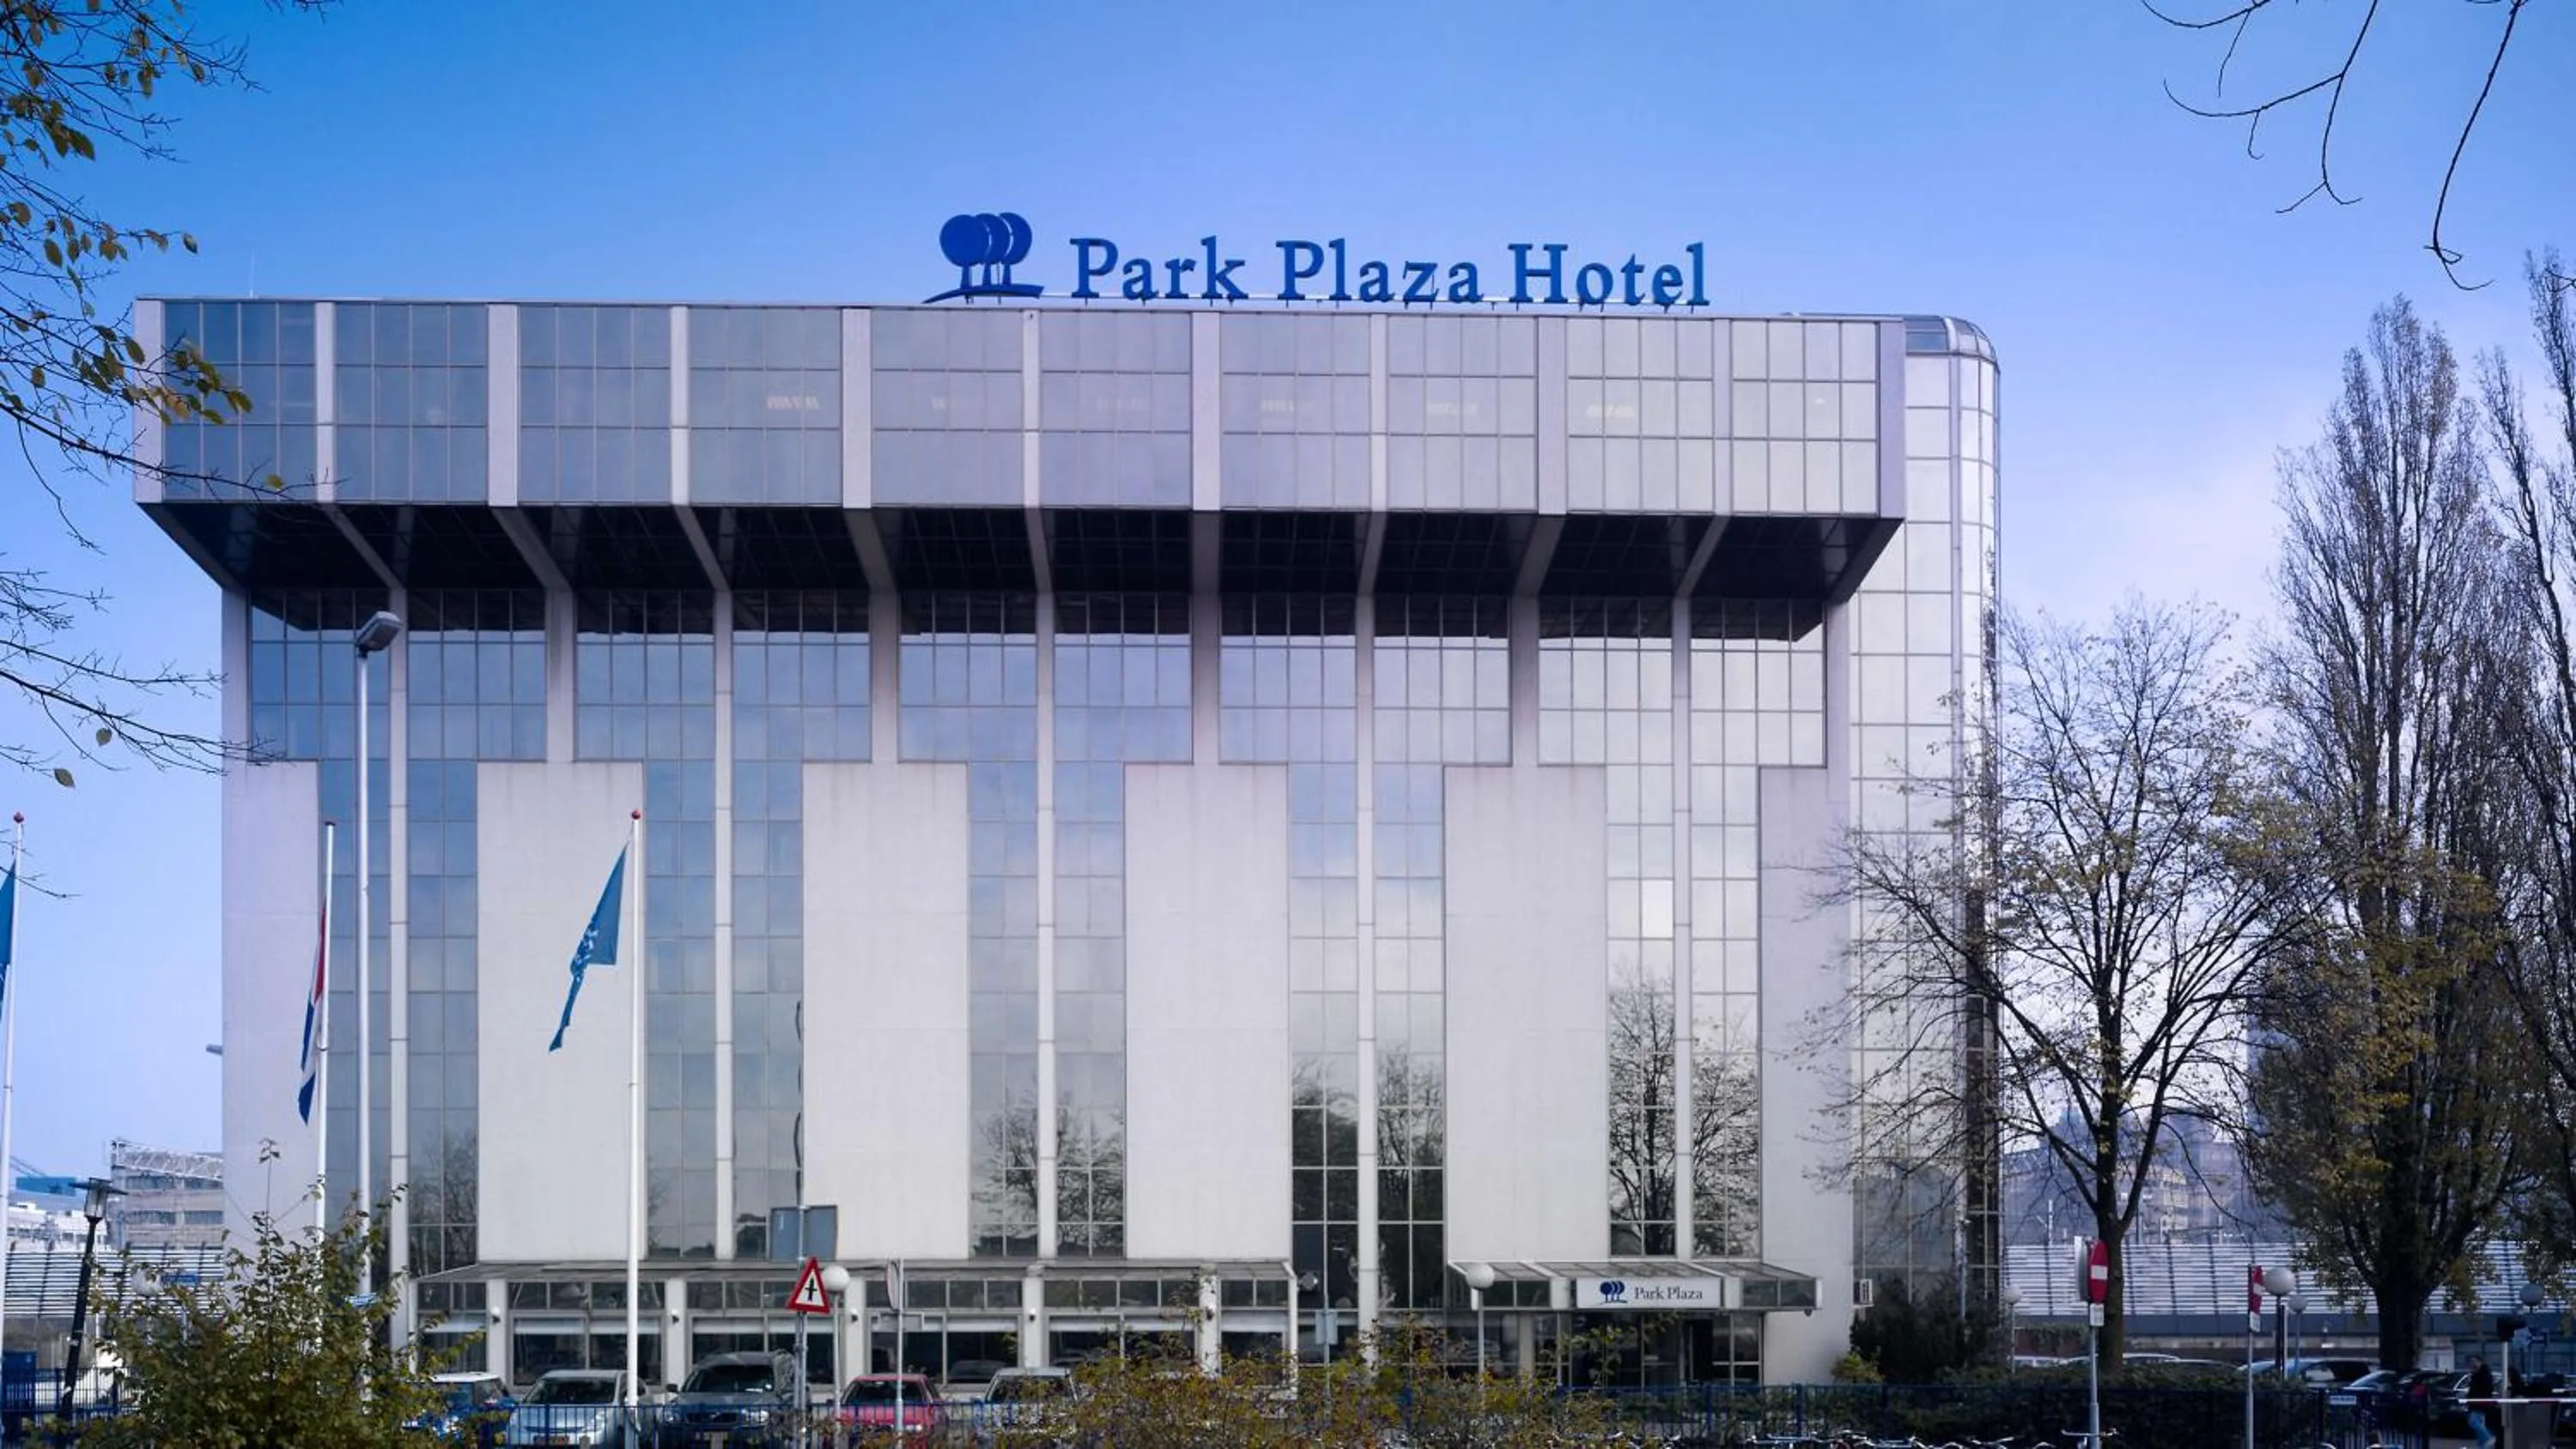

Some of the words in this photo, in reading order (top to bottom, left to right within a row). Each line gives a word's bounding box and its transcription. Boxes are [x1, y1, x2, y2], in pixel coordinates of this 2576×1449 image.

[1069, 234, 1249, 300] Park
[1275, 237, 1485, 304] Plaza
[1507, 241, 1710, 306] Hotel
[1634, 1286, 1664, 1300] Park
[1667, 1286, 1703, 1300] Plaza
